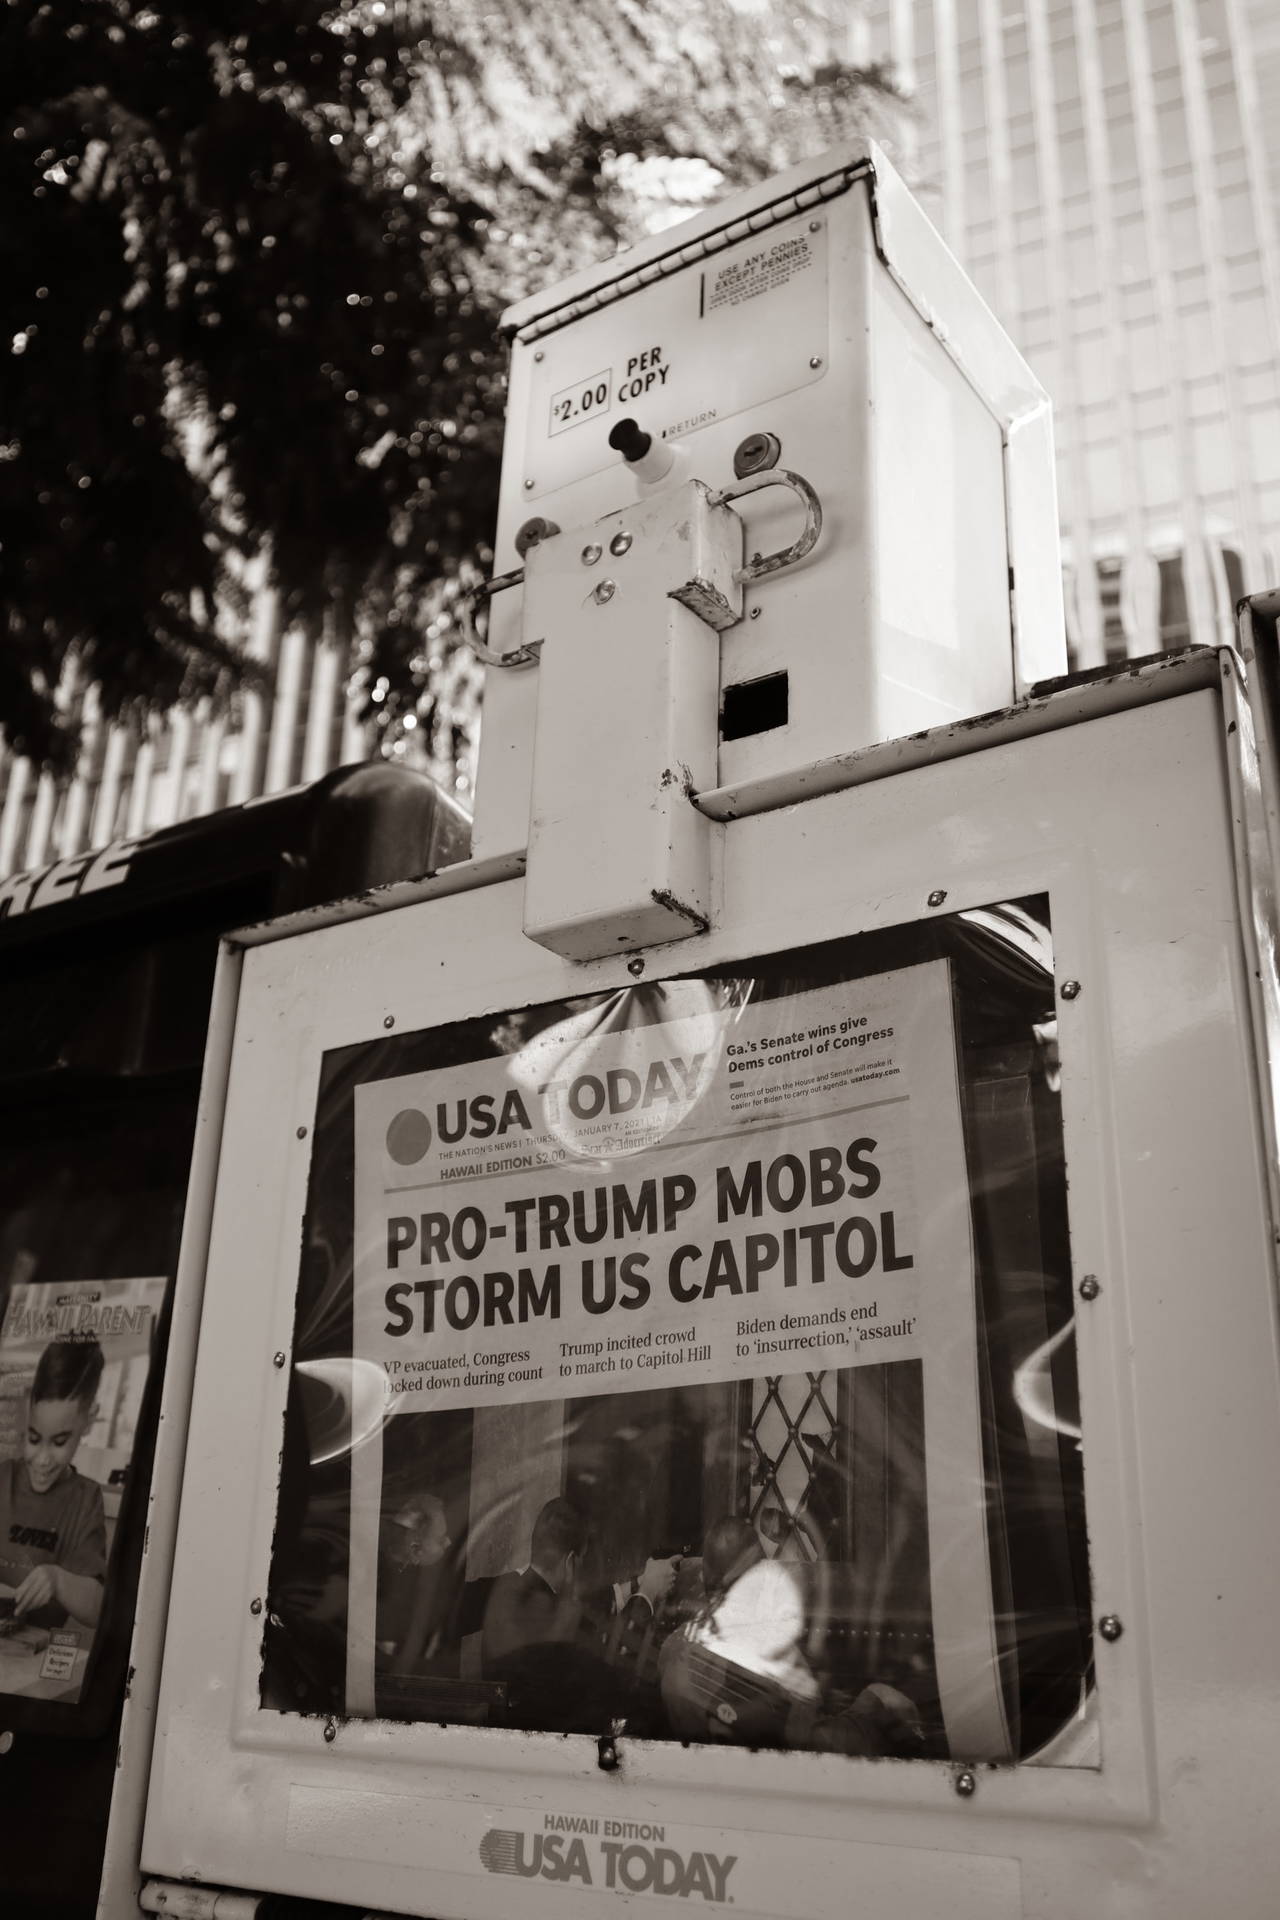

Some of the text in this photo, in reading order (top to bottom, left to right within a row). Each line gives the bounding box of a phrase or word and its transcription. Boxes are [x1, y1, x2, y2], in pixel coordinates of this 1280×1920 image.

[715, 243, 808, 292] EXCEPT PENNIES
[718, 236, 806, 280] USE ANY COINS
[627, 346, 661, 377] PER
[553, 364, 670, 422] $2.00 COPY
[668, 409, 718, 436] RETURN
[728, 1027, 894, 1073] Dems control of Congress
[761, 1032, 805, 1050] Senate
[808, 1024, 836, 1040] wins
[840, 1016, 868, 1034] give
[730, 1058, 893, 1101] Control of both the House and Senate will make it
[731, 1100, 751, 1111] easier
[752, 1096, 763, 1107] for
[763, 1093, 783, 1105] Biden
[784, 1091, 791, 1100] to
[792, 1087, 809, 1099] carry
[810, 1085, 822, 1095] out
[850, 1067, 901, 1085] usatoday.com
[437, 1053, 706, 1144] USA TODAY
[439, 1151, 454, 1160] THE
[455, 1144, 493, 1159] NATION'S
[494, 1140, 518, 1151] NEWS
[574, 1123, 612, 1138] JANUARY
[440, 1148, 566, 1180] HAWAII EDITION $2.00
[387, 1138, 882, 1269] PRO-TRUMP MOBS
[383, 1210, 914, 1337] STORM US CAPITOL
[76, 1304, 151, 1334] PARENT
[736, 1301, 878, 1336] Biden demands end
[559, 1326, 696, 1357] Trump incited crowd
[736, 1343, 750, 1357] to
[383, 1350, 530, 1374] VP evacuated, Congress
[426, 1375, 460, 1391] down
[463, 1370, 505, 1387] during
[508, 1366, 543, 1382] count
[559, 1345, 711, 1377] to march to Capitol Hill
[544, 1814, 665, 1842] HAWAII EDITION
[515, 1832, 592, 1885] USA
